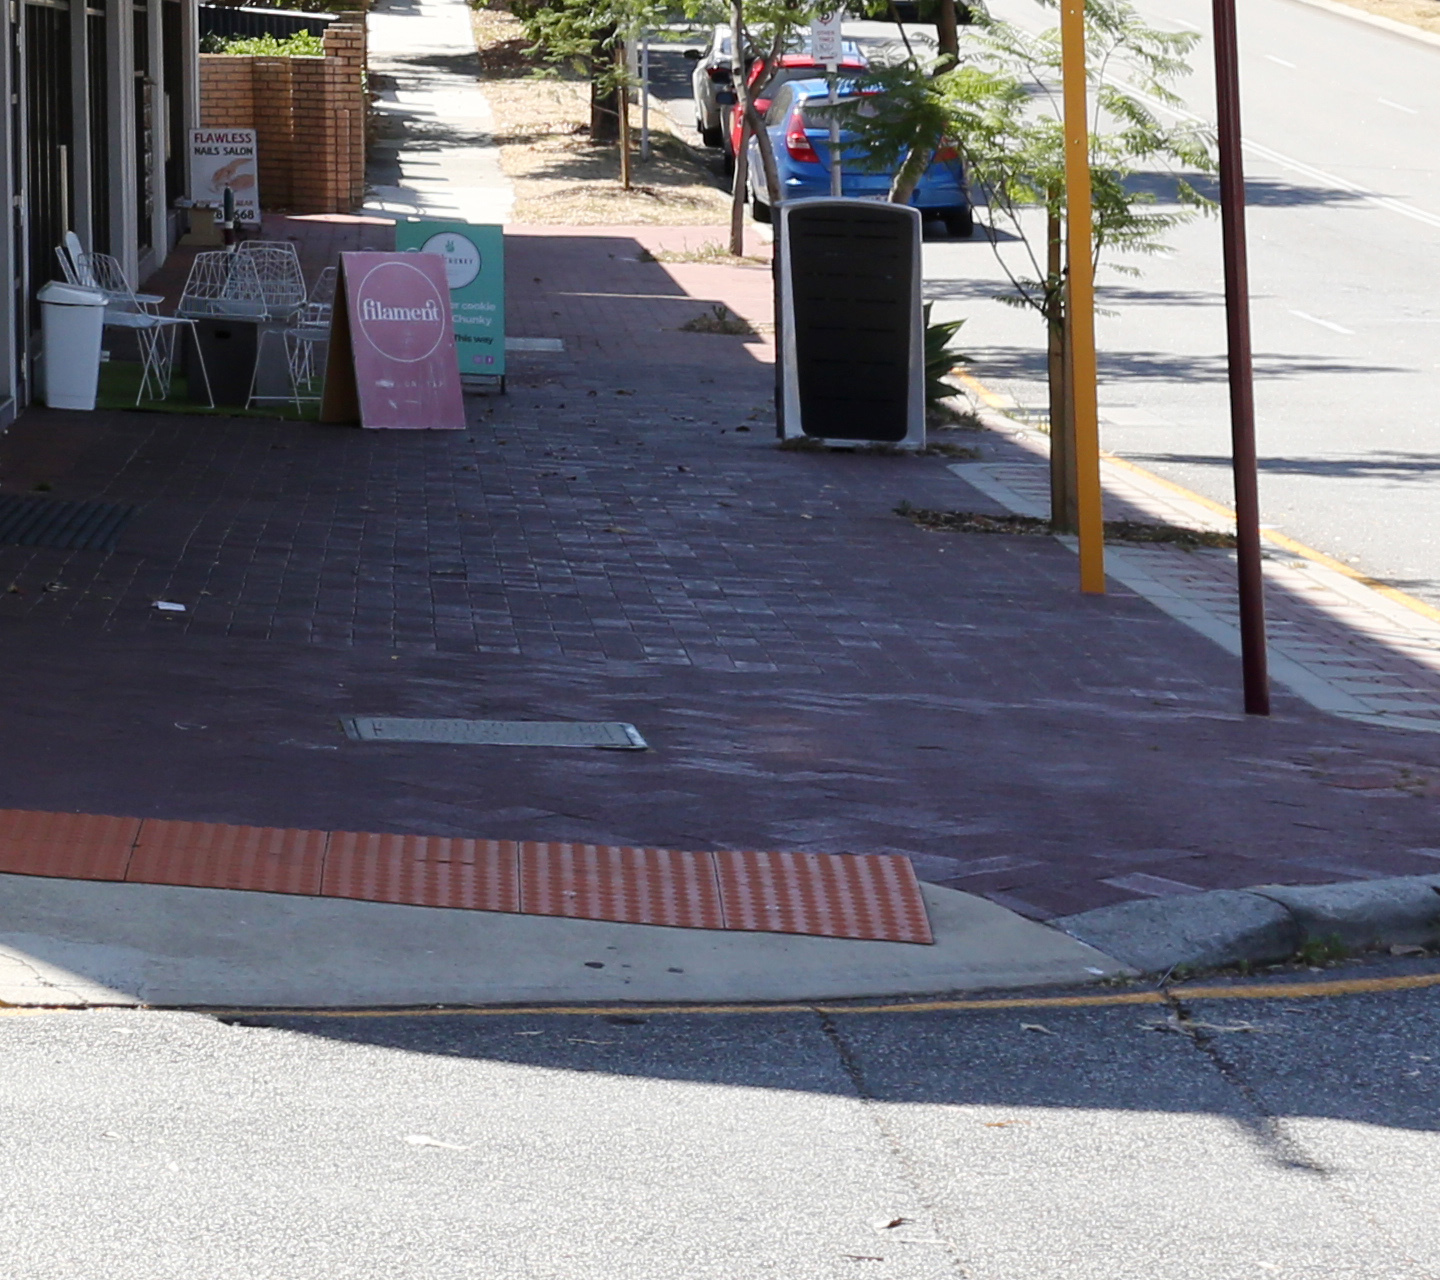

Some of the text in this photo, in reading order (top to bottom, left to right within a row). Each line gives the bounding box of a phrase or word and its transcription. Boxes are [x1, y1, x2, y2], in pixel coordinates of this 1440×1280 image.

[194, 132, 252, 144] FLAWLESS
[194, 146, 253, 156] NAILS SALON
[362, 298, 441, 322] filament
[461, 302, 496, 311] cookie
[451, 314, 492, 326] Chunky
[474, 336, 493, 346] way
